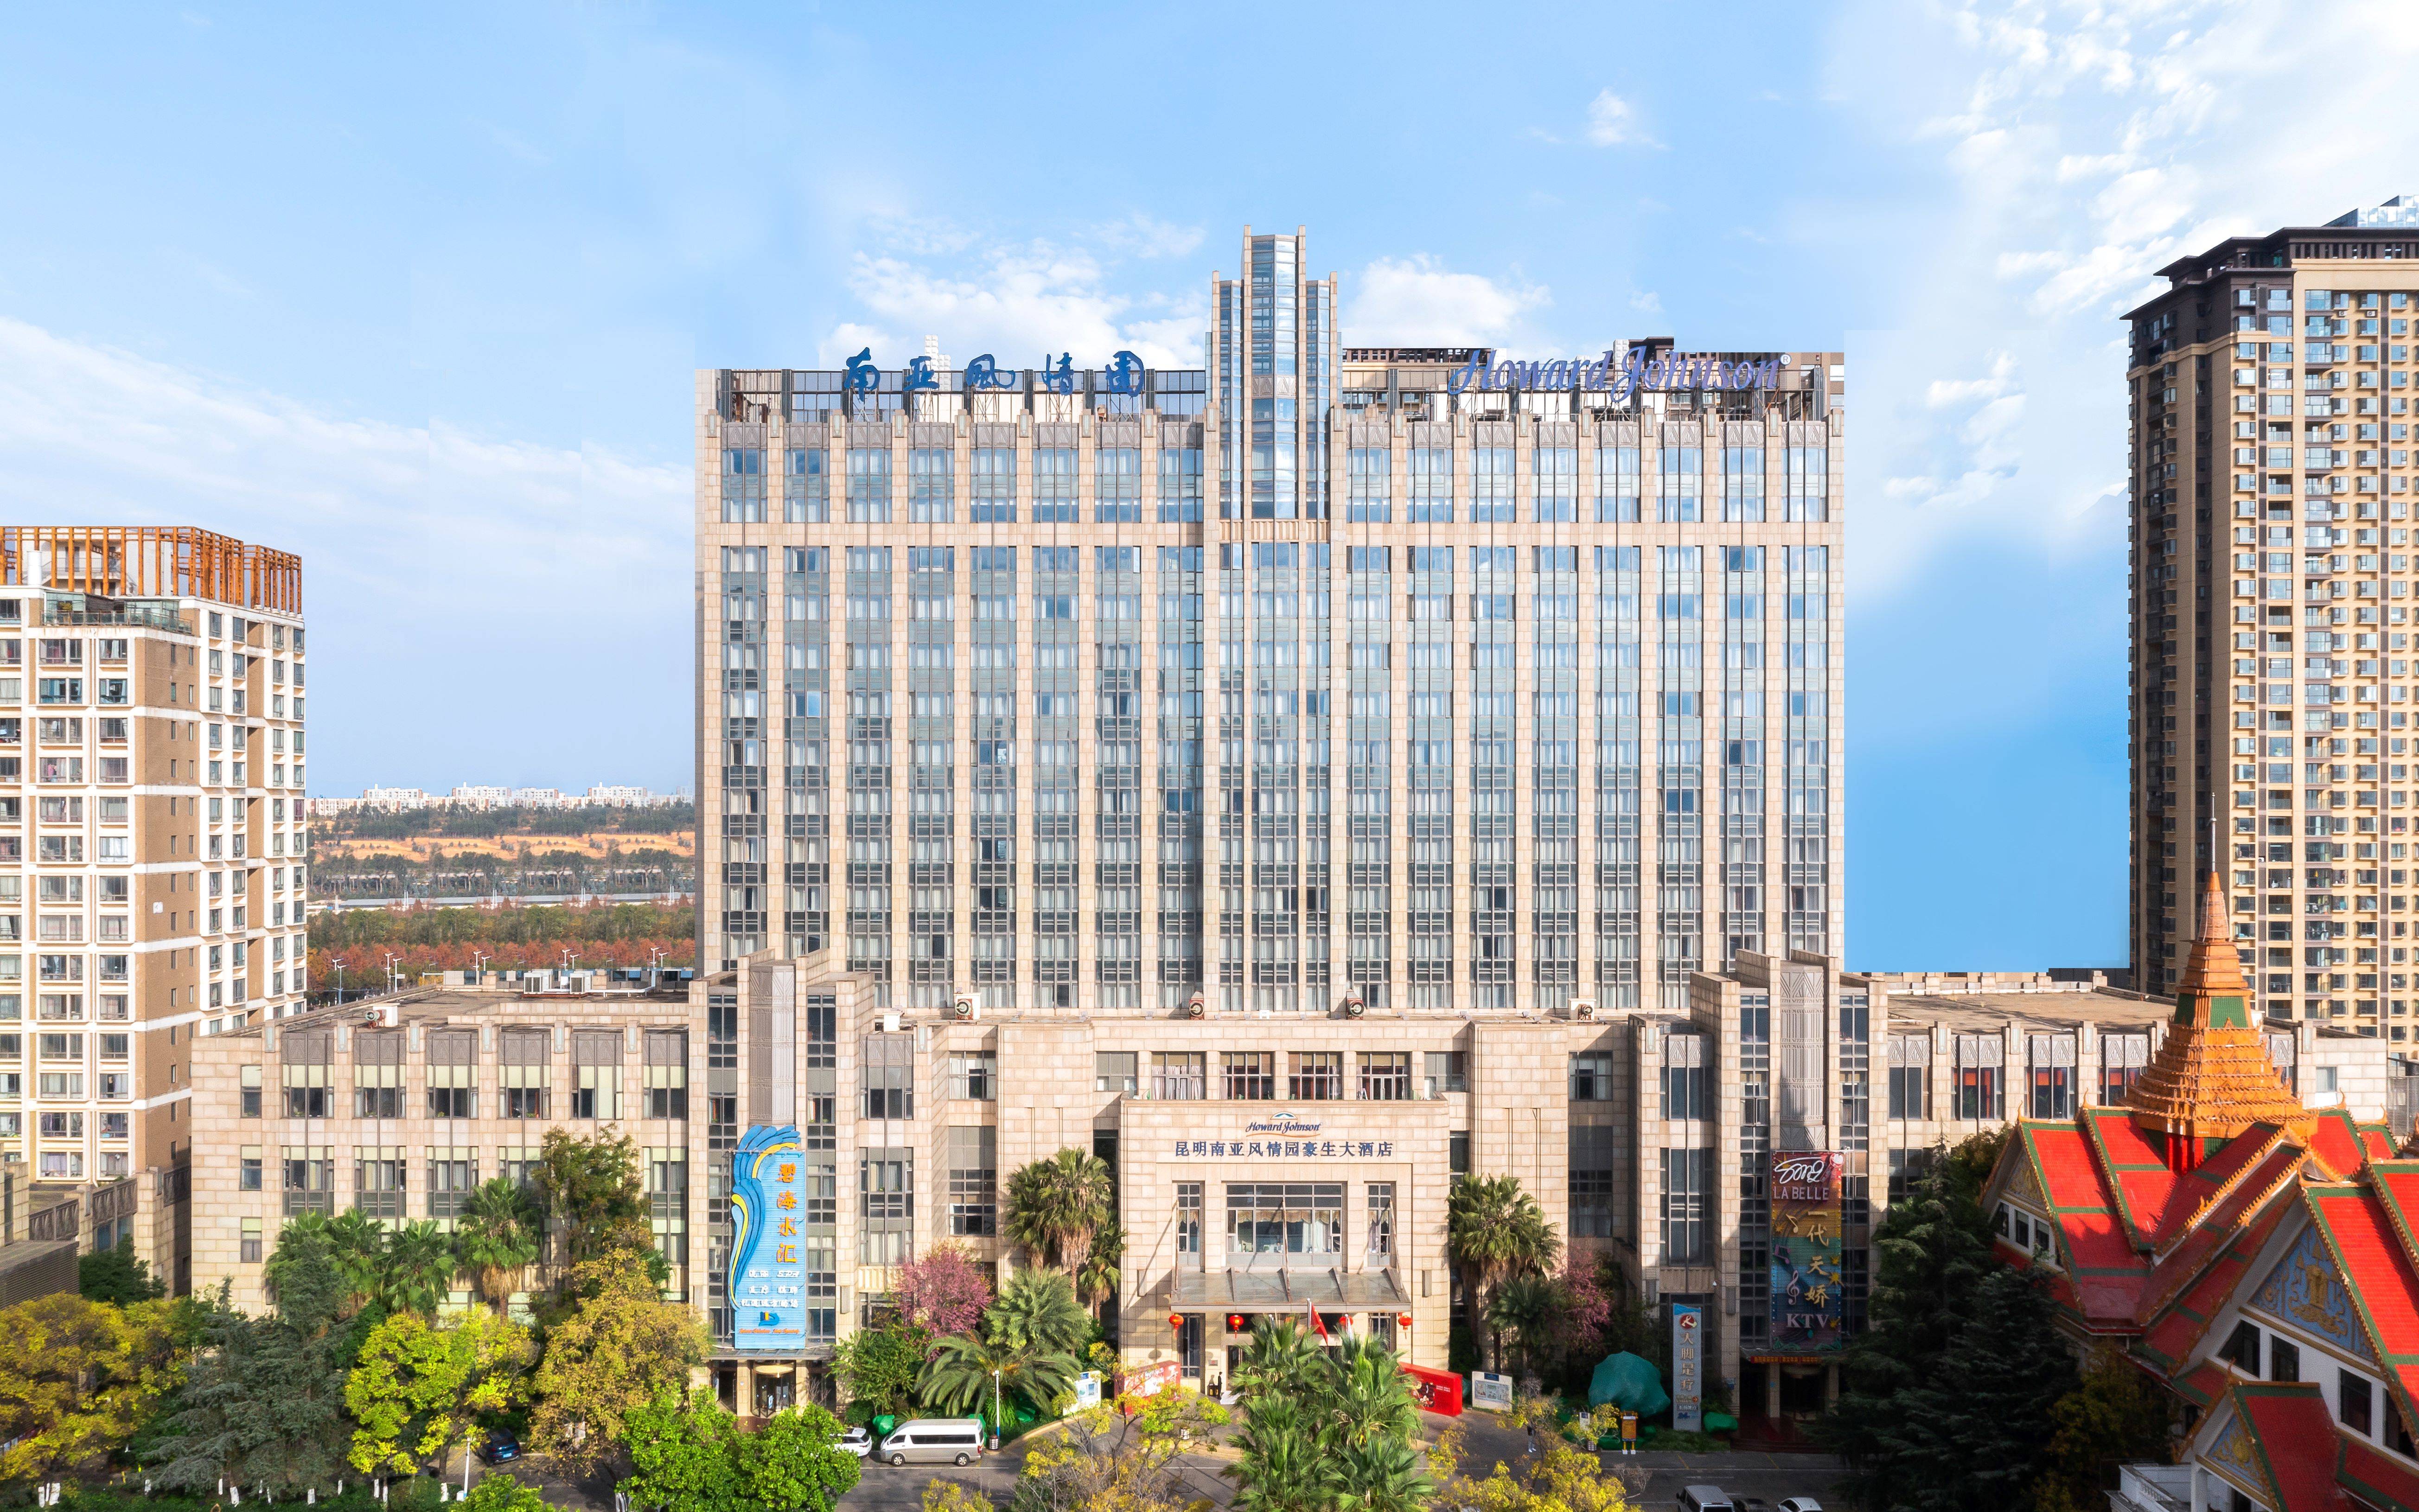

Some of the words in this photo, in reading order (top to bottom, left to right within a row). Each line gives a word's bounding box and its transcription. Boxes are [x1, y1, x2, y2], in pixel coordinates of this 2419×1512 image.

[1448, 349, 1614, 395] Howard
[1610, 346, 1779, 402] Johnson
[1245, 1122, 1283, 1133] Howard
[1282, 1121, 1321, 1134] Johnson
[1175, 1141, 1393, 1157] 昆明南亚风情园豪生大酒店
[1774, 1186, 1789, 1199] LA
[1792, 1187, 1830, 1200] BELLE
[775, 1162, 798, 1263] 碧海水汇
[1804, 1211, 1830, 1308] 一代天娇
[1786, 1313, 1829, 1328] KTV
[1679, 1332, 1694, 1391] 大脚足疗
